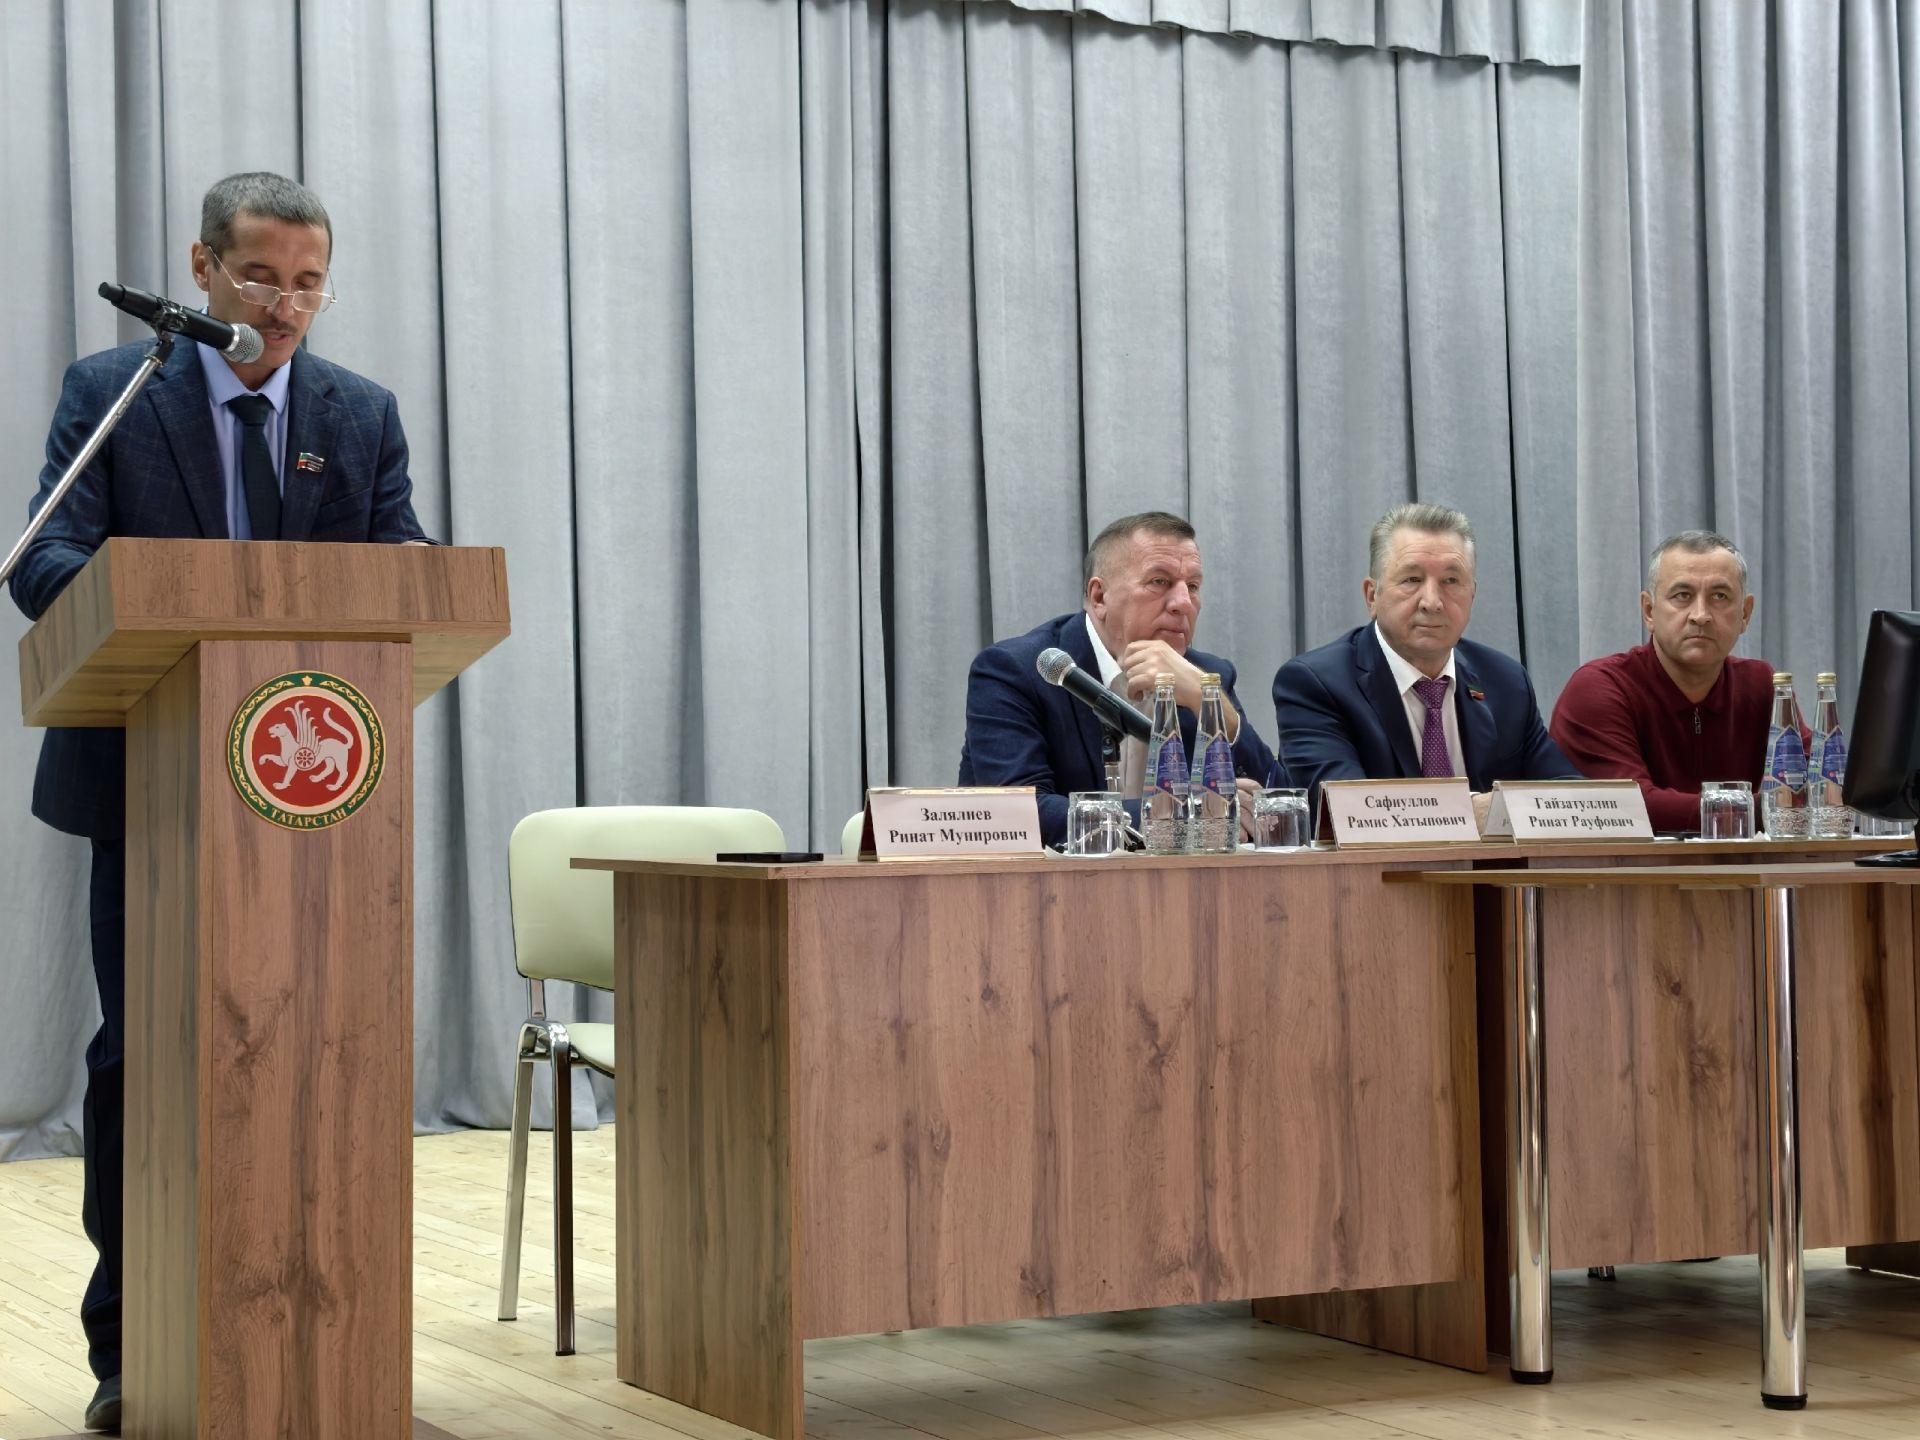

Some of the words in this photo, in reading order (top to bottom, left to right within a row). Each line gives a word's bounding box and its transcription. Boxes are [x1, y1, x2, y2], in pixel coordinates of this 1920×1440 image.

[1364, 795, 1439, 811] Сафиуллов
[1534, 797, 1618, 812] Гайзатуллин
[270, 808, 347, 827] ТАТАРСТАН
[921, 807, 992, 821] Залялиев
[1347, 816, 1389, 828] Рамис
[1528, 815, 1568, 828] Ринат
[1571, 815, 1634, 830] Рауфович
[889, 829, 935, 843] Ринат
[940, 828, 1028, 845] Мунирович
